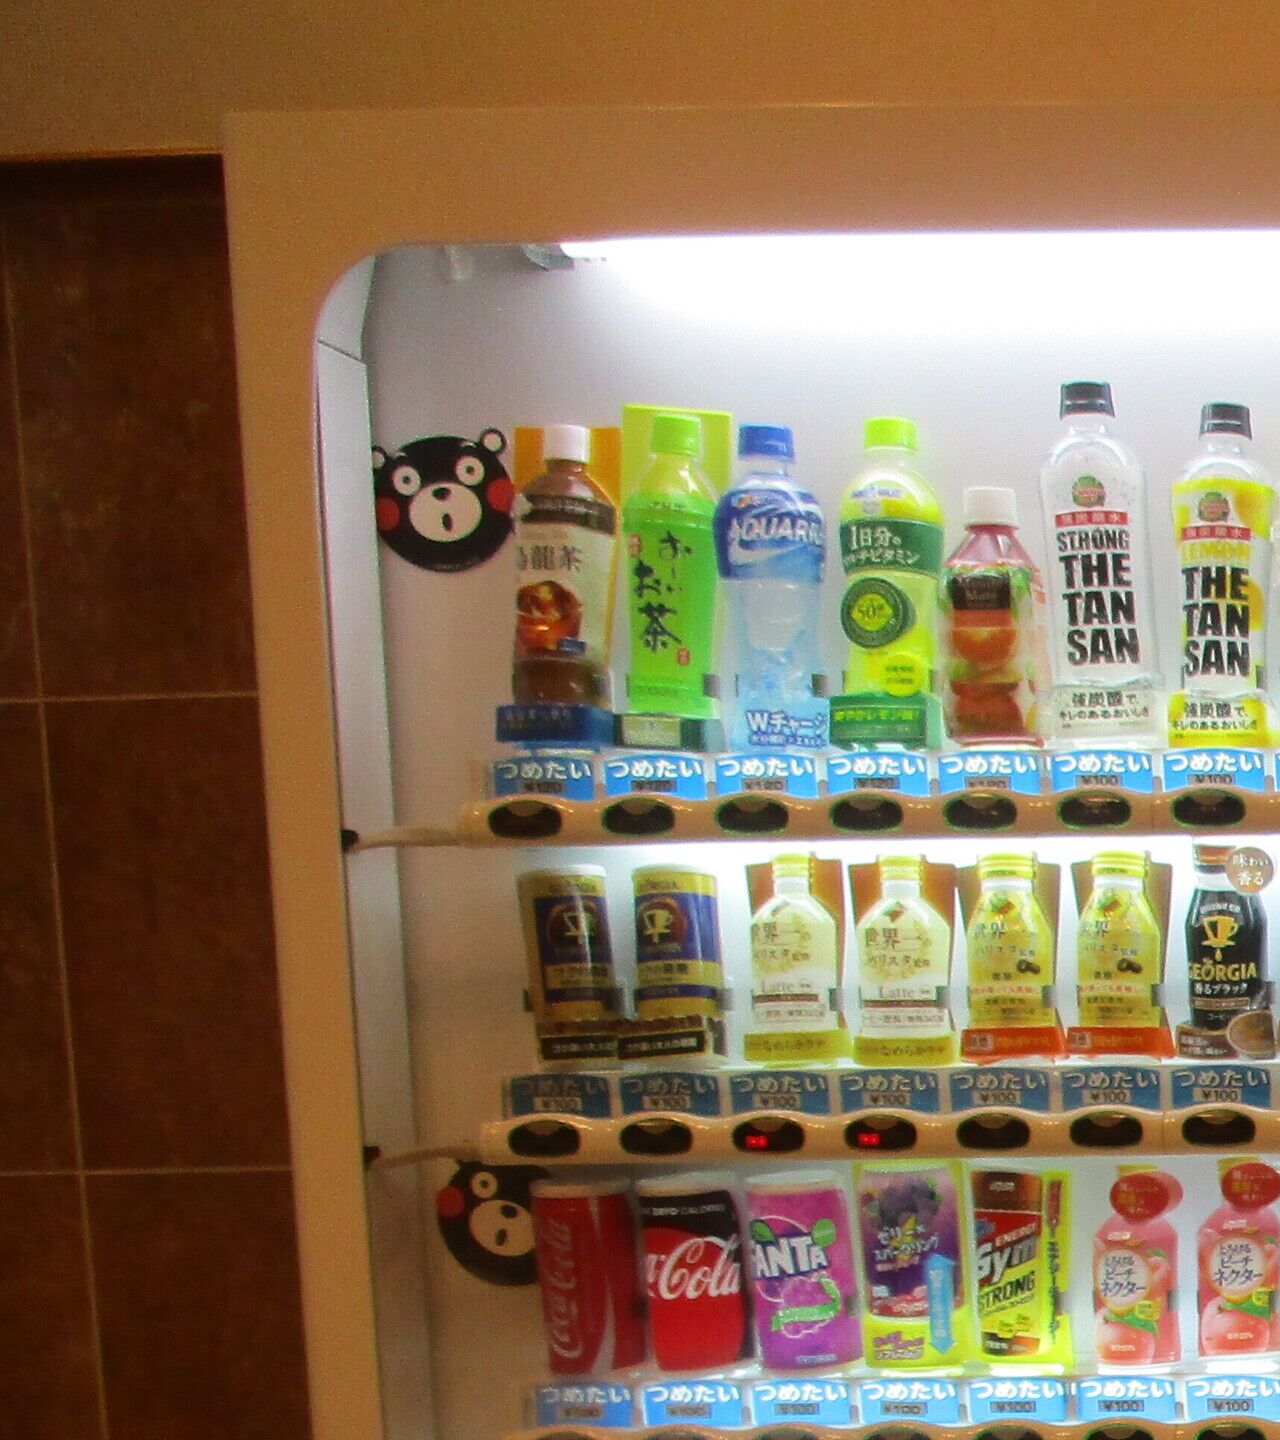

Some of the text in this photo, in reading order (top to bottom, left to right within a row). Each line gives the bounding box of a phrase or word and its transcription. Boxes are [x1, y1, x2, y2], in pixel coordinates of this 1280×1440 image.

[1056, 529, 1130, 552] STRONG
[1059, 553, 1132, 589] THE
[1181, 566, 1250, 600] THE
[631, 559, 683, 653] お茶
[1062, 590, 1135, 627] TAN
[1182, 603, 1251, 639] TAN
[1066, 627, 1140, 665] SAN
[1184, 640, 1250, 678] SAN
[498, 761, 592, 780] つめたい
[607, 759, 703, 779] つめたい
[718, 757, 816, 778] つめたい
[828, 755, 926, 776] つめたい
[940, 754, 1038, 775] つめたい
[1054, 753, 1150, 774] つめたい
[1165, 752, 1262, 772] つめたい
[1237, 871, 1265, 886] 香る
[622, 1077, 717, 1096] つめたい
[735, 1076, 826, 1095] つめたい
[840, 1074, 937, 1092] つめたい
[953, 1073, 1047, 1091] つめたい
[1067, 1072, 1159, 1090] つめたい
[1174, 1069, 1268, 1088] つめたい
[1200, 1088, 1238, 1102] ¥100
[1220, 1256, 1252, 1270] ピーチ
[1105, 1267, 1136, 1282] ピーチ
[1213, 1269, 1263, 1286] ネクター
[1101, 1281, 1147, 1298] ネクター
[540, 1386, 631, 1403] つめたい
[651, 1385, 739, 1403] つめたい
[755, 1384, 847, 1401] つめたい
[862, 1383, 956, 1400] つめたい
[971, 1382, 1065, 1399] つめたい
[1080, 1381, 1173, 1398] つめたい
[1211, 1399, 1249, 1412] ¥100
